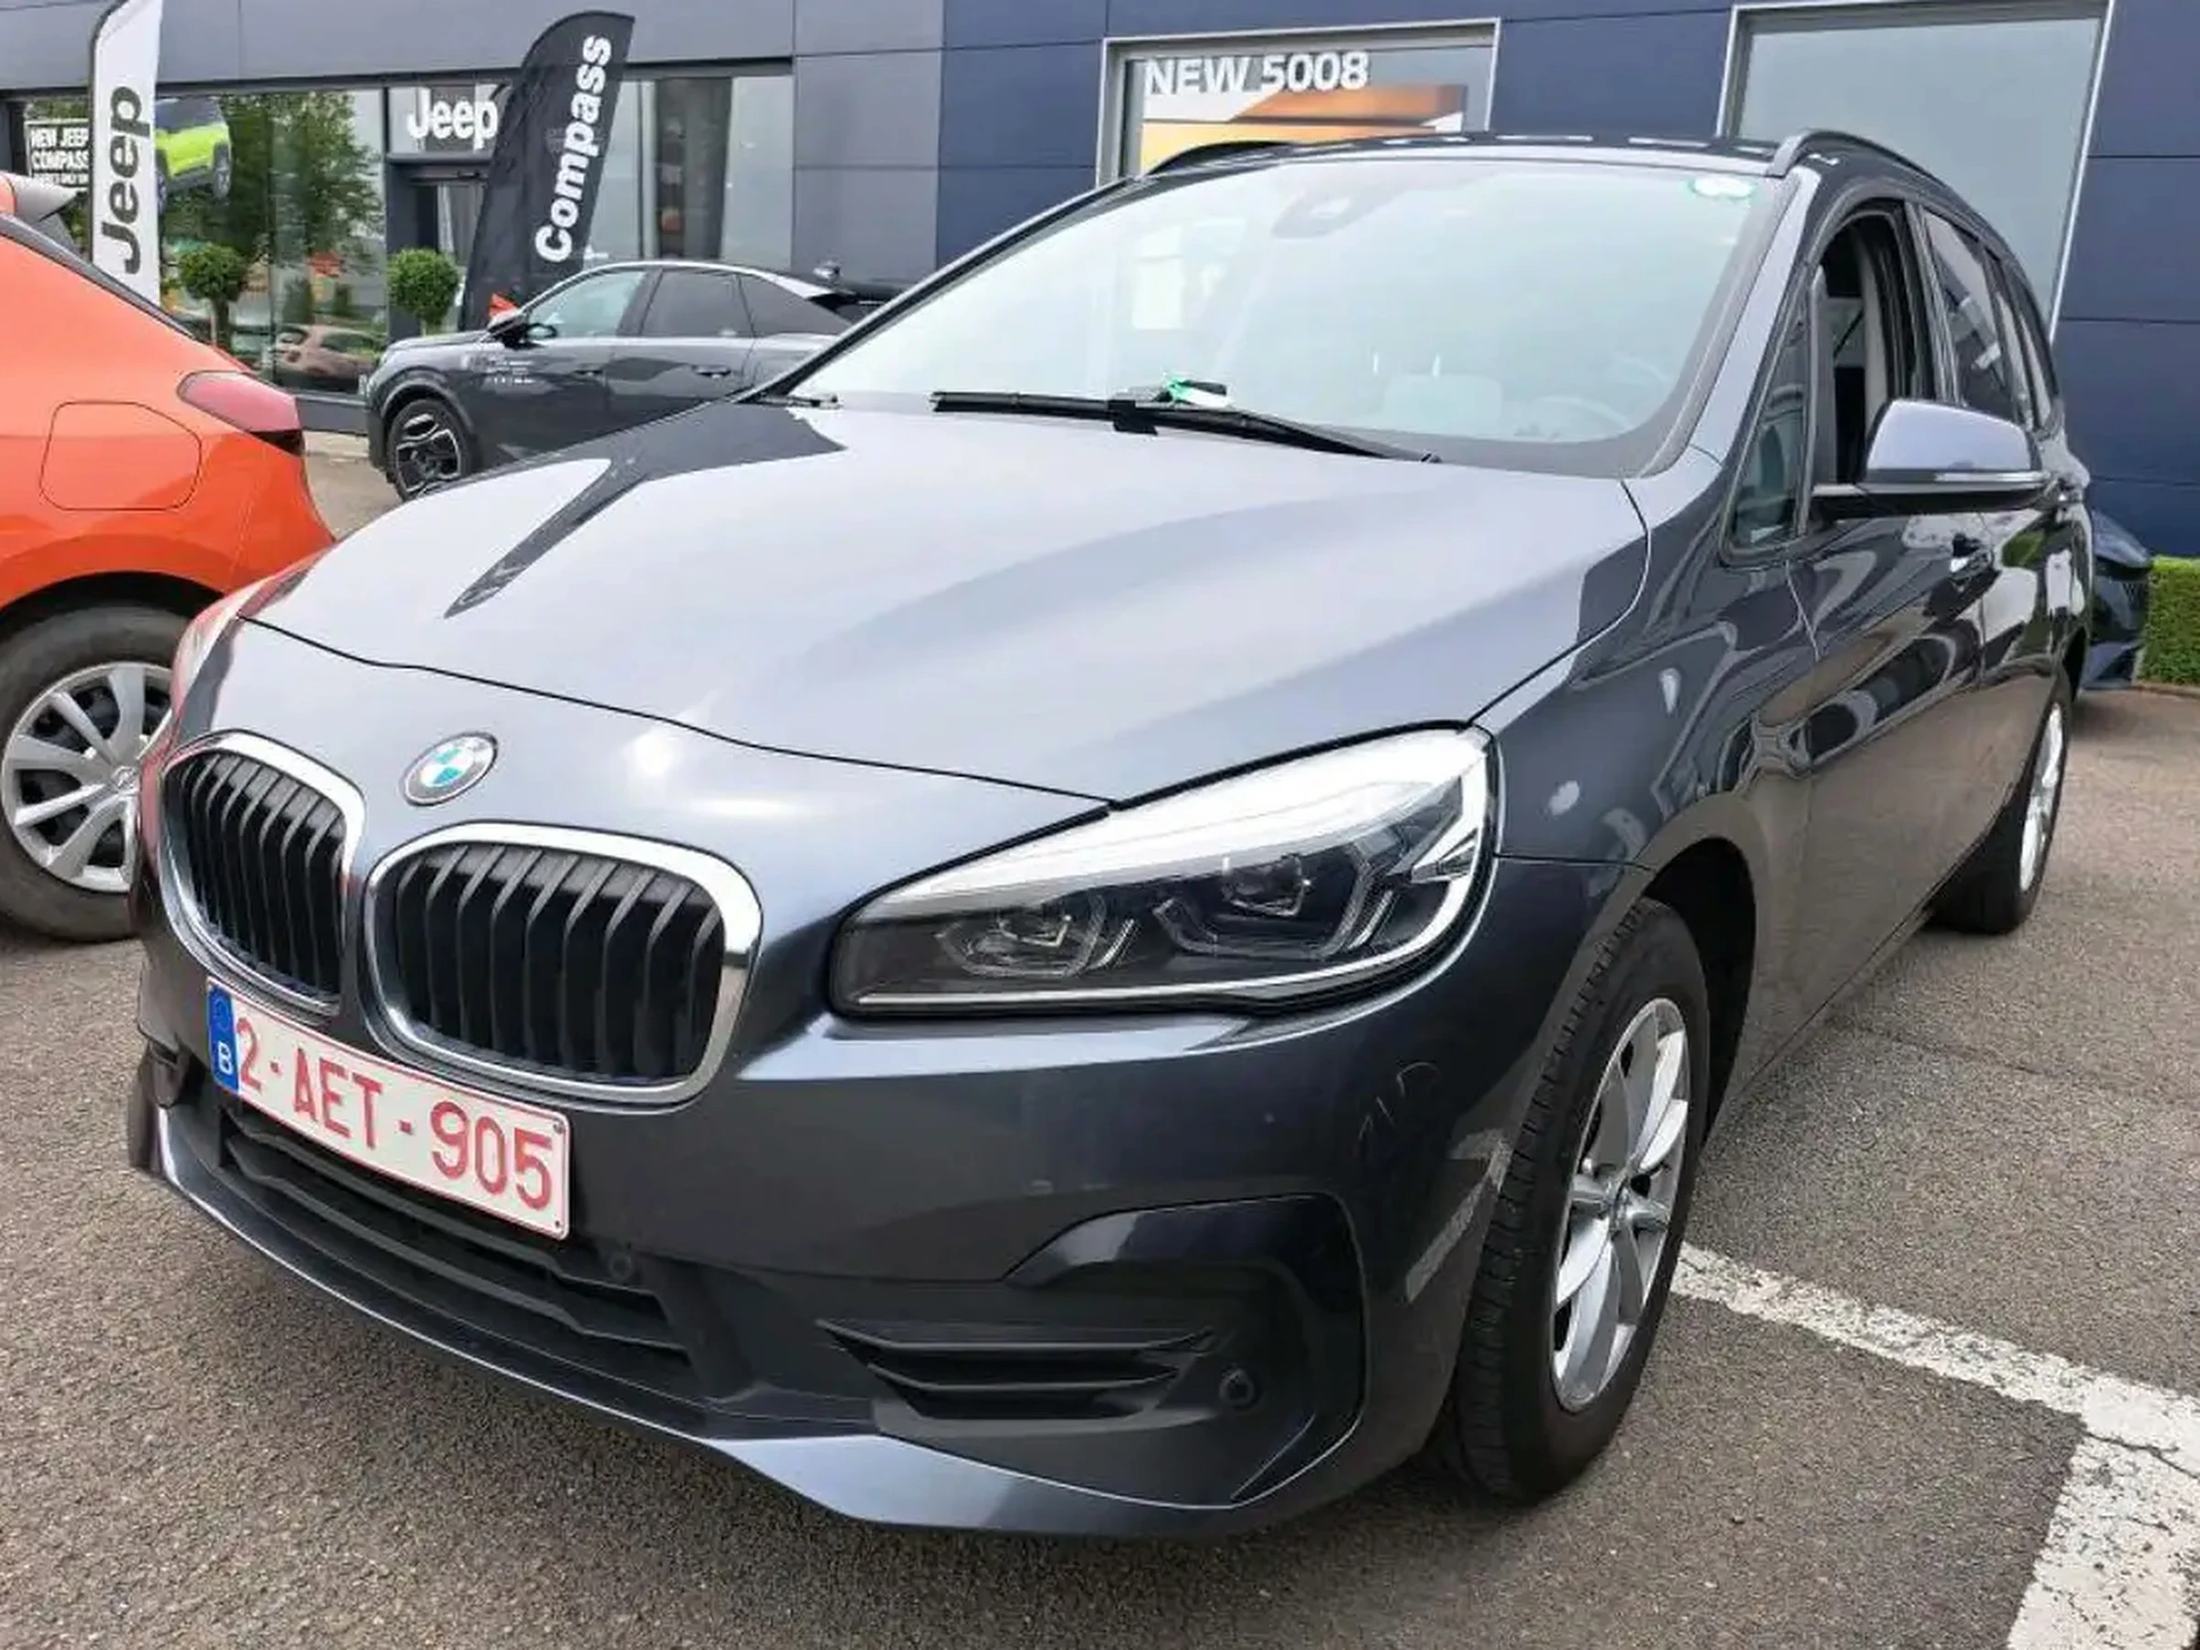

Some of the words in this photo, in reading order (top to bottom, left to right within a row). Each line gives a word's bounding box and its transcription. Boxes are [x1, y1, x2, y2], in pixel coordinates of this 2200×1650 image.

[406, 86, 498, 150] Jeep
[1145, 56, 1249, 95] NEW
[1260, 51, 1369, 92] 5008
[102, 86, 150, 275] Jeep
[535, 35, 612, 262] Compass
[217, 1042, 233, 1075] B
[236, 1017, 553, 1210] 2-AET-905
